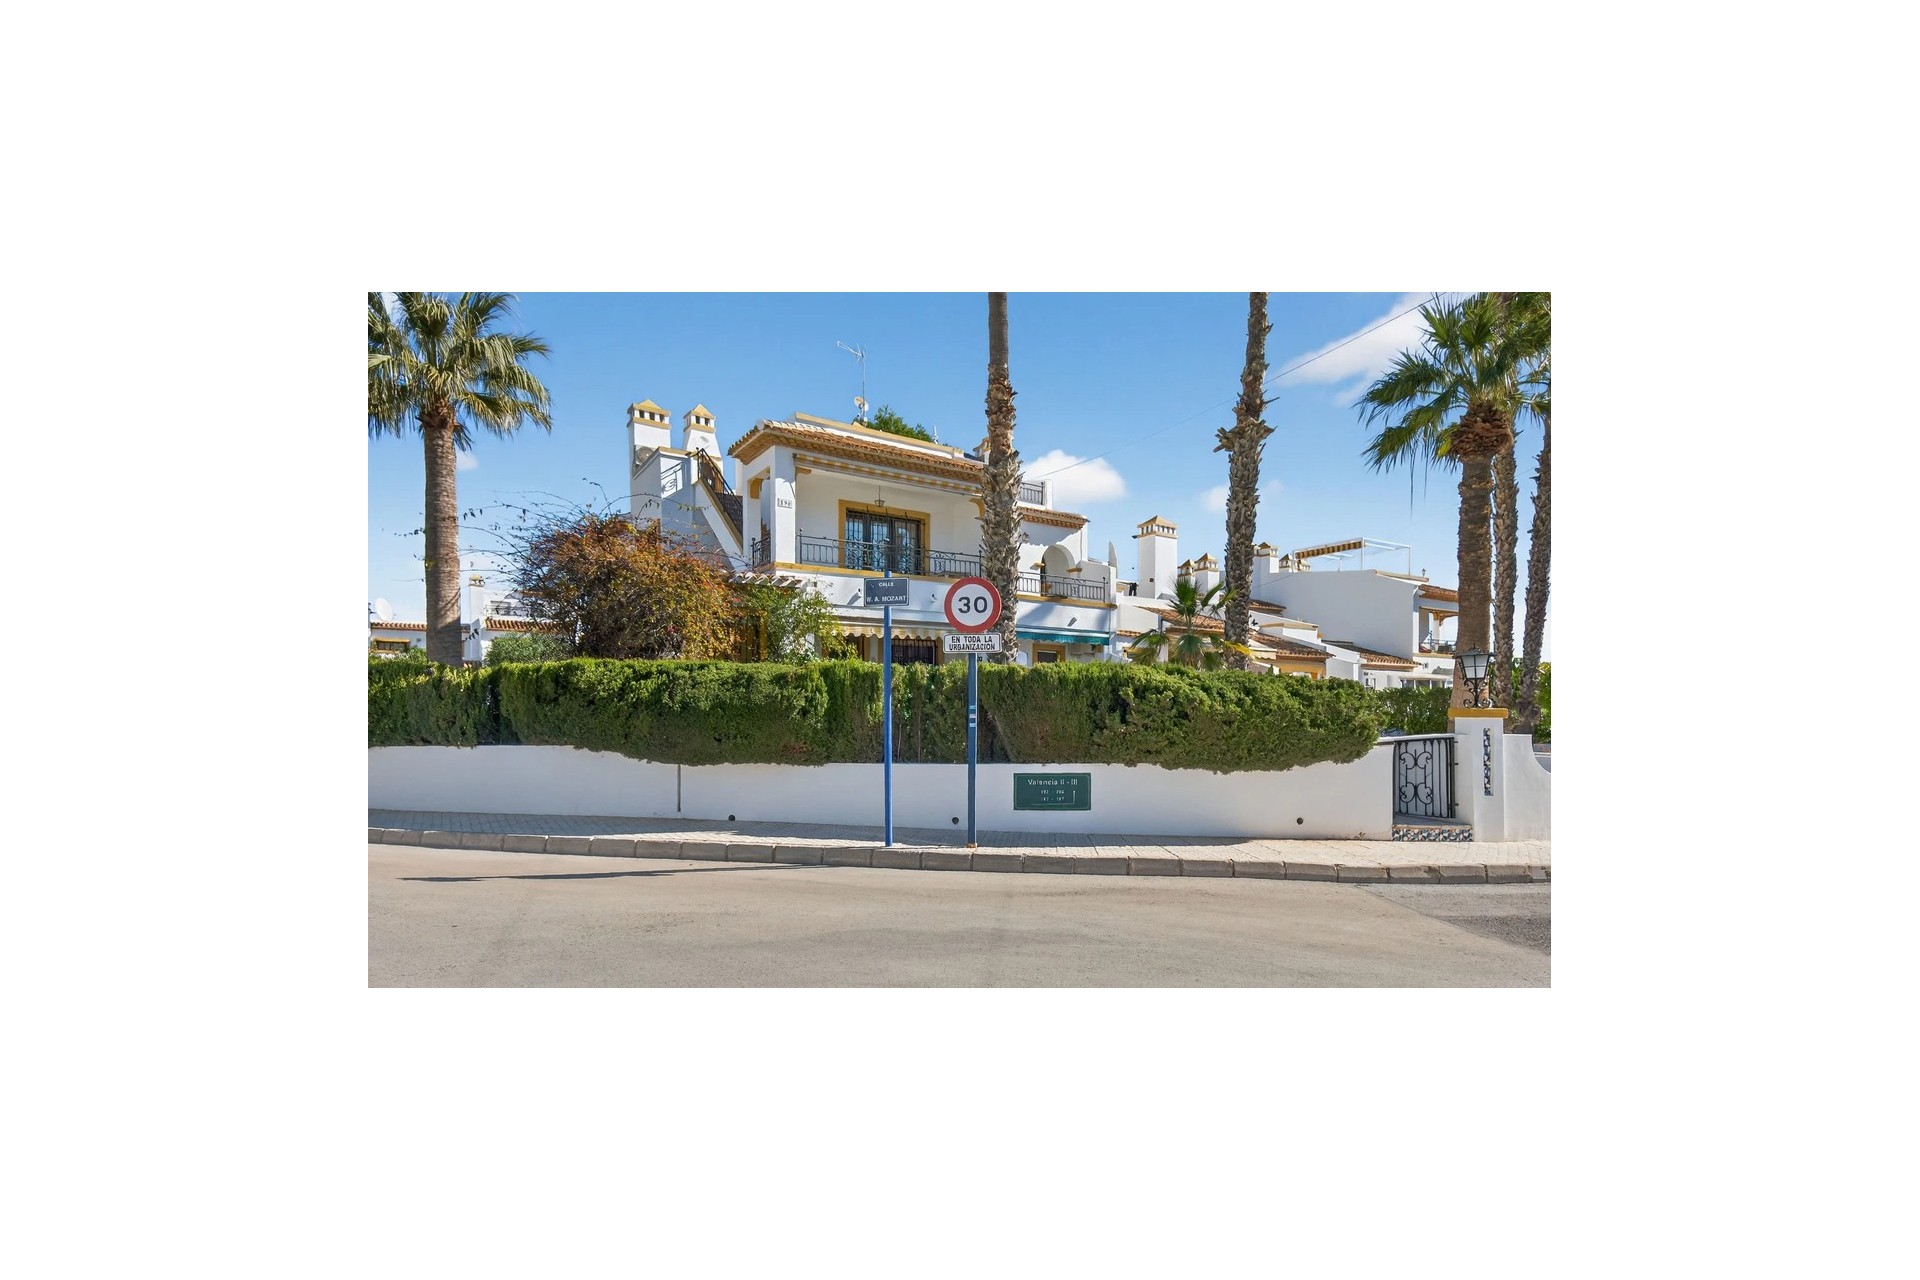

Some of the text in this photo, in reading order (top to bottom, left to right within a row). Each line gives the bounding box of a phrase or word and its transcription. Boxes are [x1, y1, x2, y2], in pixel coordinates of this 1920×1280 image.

[958, 596, 988, 614] 30
[951, 635, 993, 644] EN TODA LA
